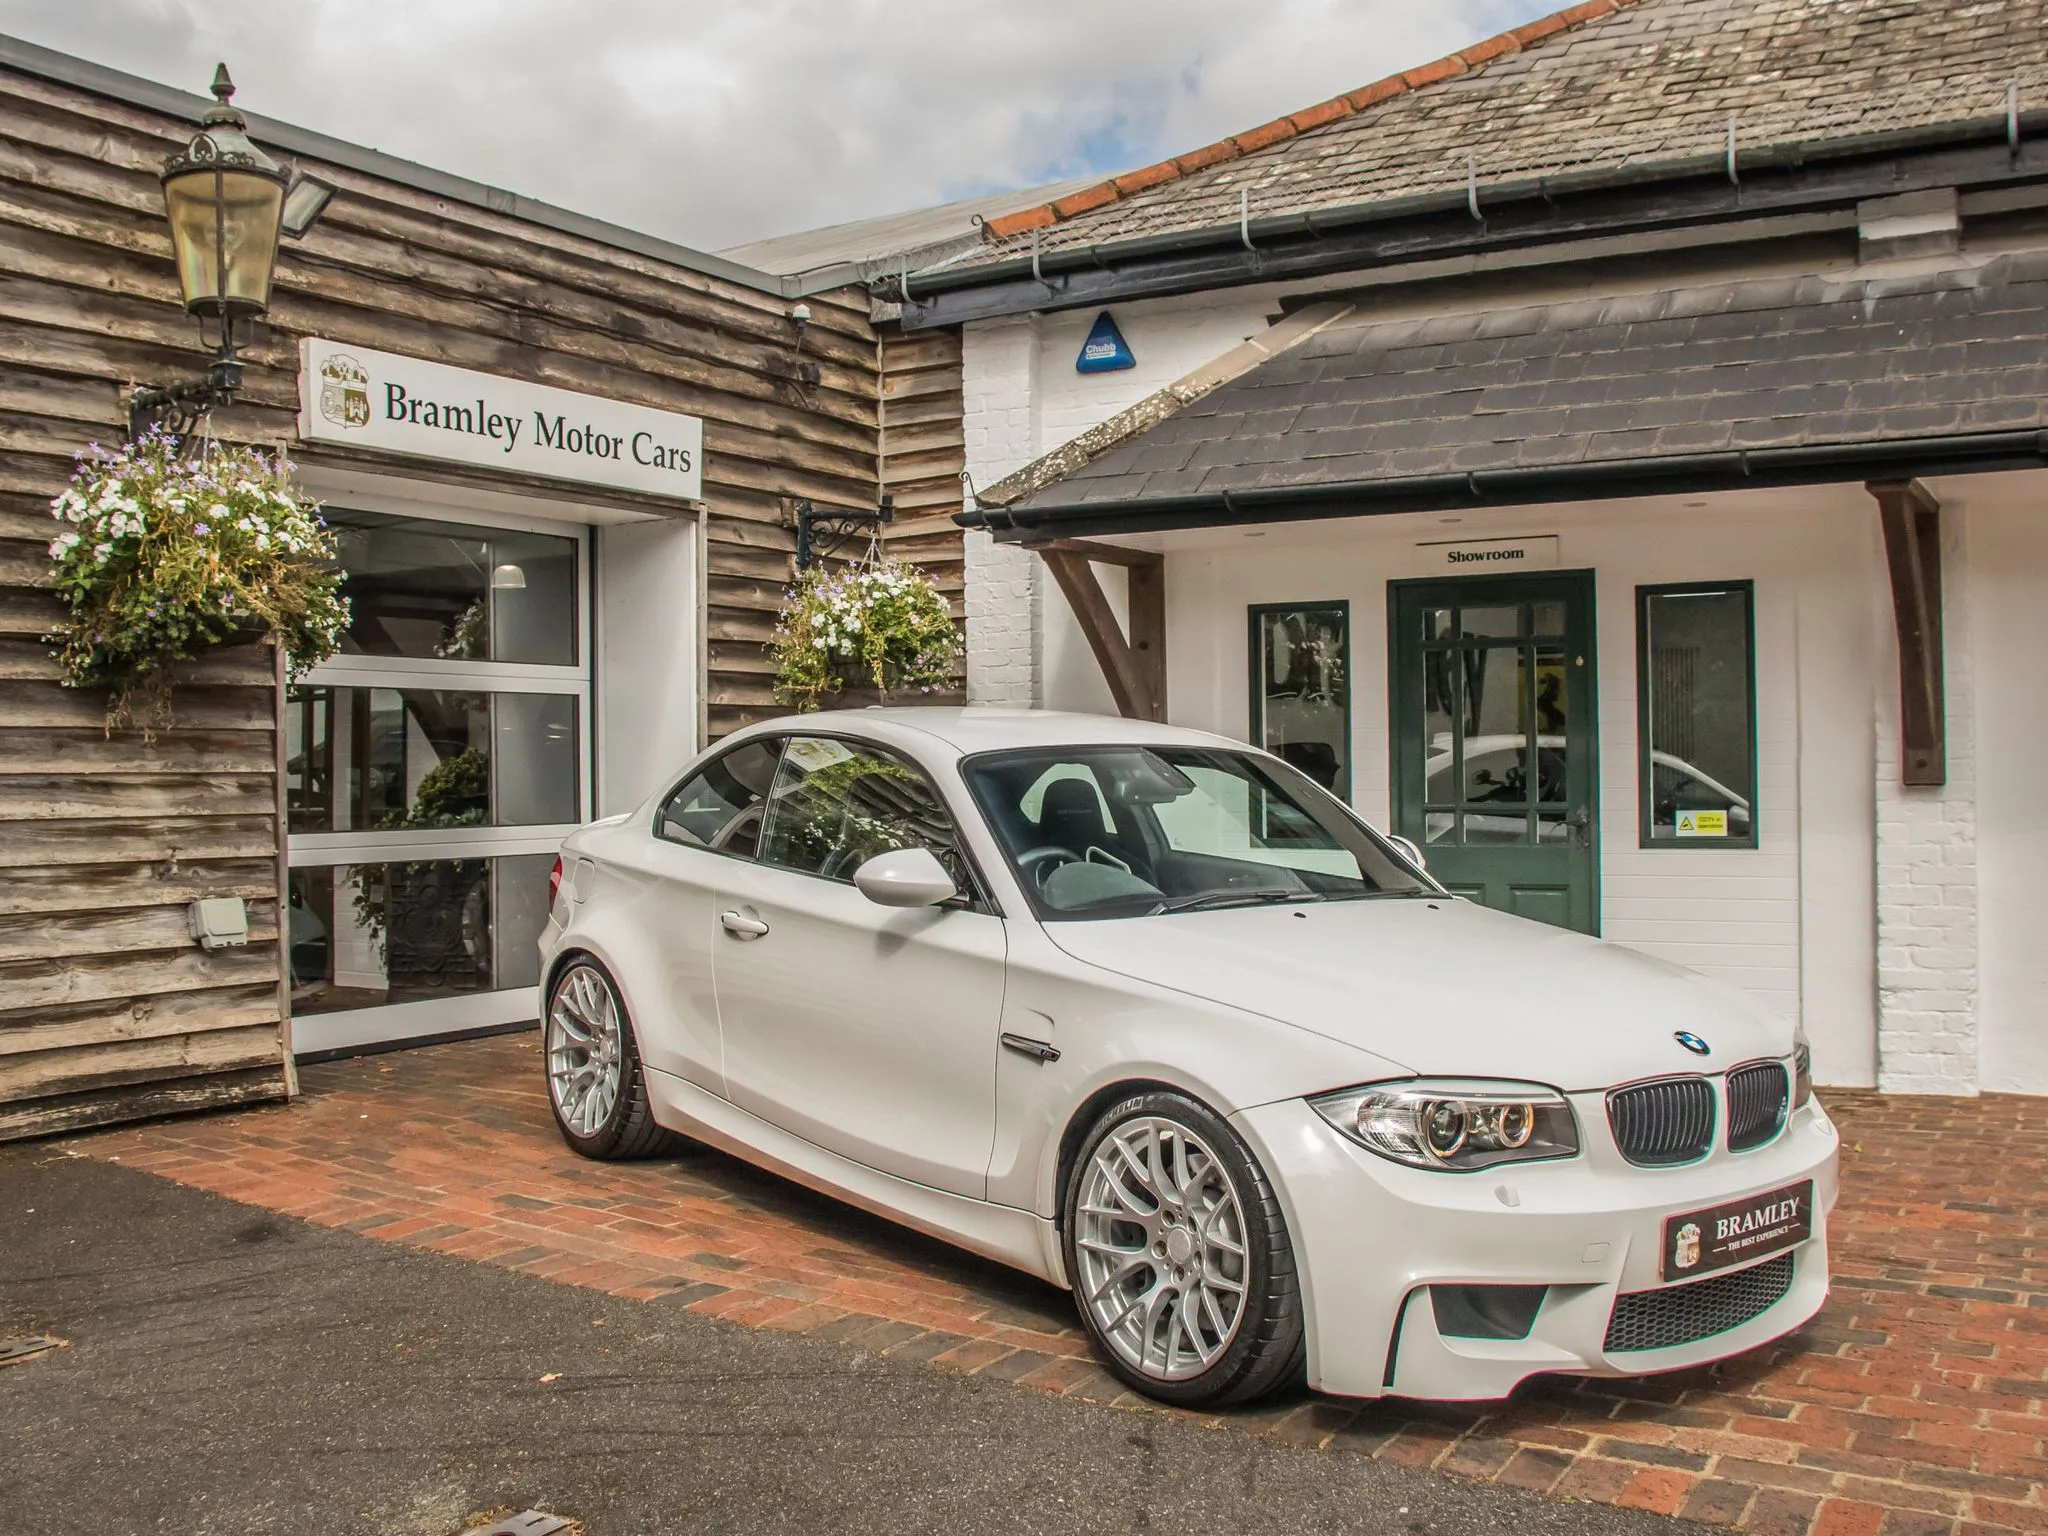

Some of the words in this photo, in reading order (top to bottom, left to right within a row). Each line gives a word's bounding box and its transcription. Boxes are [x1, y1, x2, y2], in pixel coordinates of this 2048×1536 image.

[1086, 343, 1116, 354] Chubb
[383, 382, 523, 453] Bramley
[533, 411, 624, 461] Motor
[631, 432, 692, 474] Cars
[1448, 549, 1524, 563] Showroom
[1716, 1197, 1800, 1240] BRAMLEY
[1728, 1241, 1740, 1250] THE
[1741, 1236, 1756, 1247] BEST
[1756, 1225, 1789, 1242] EXPERIENCE
